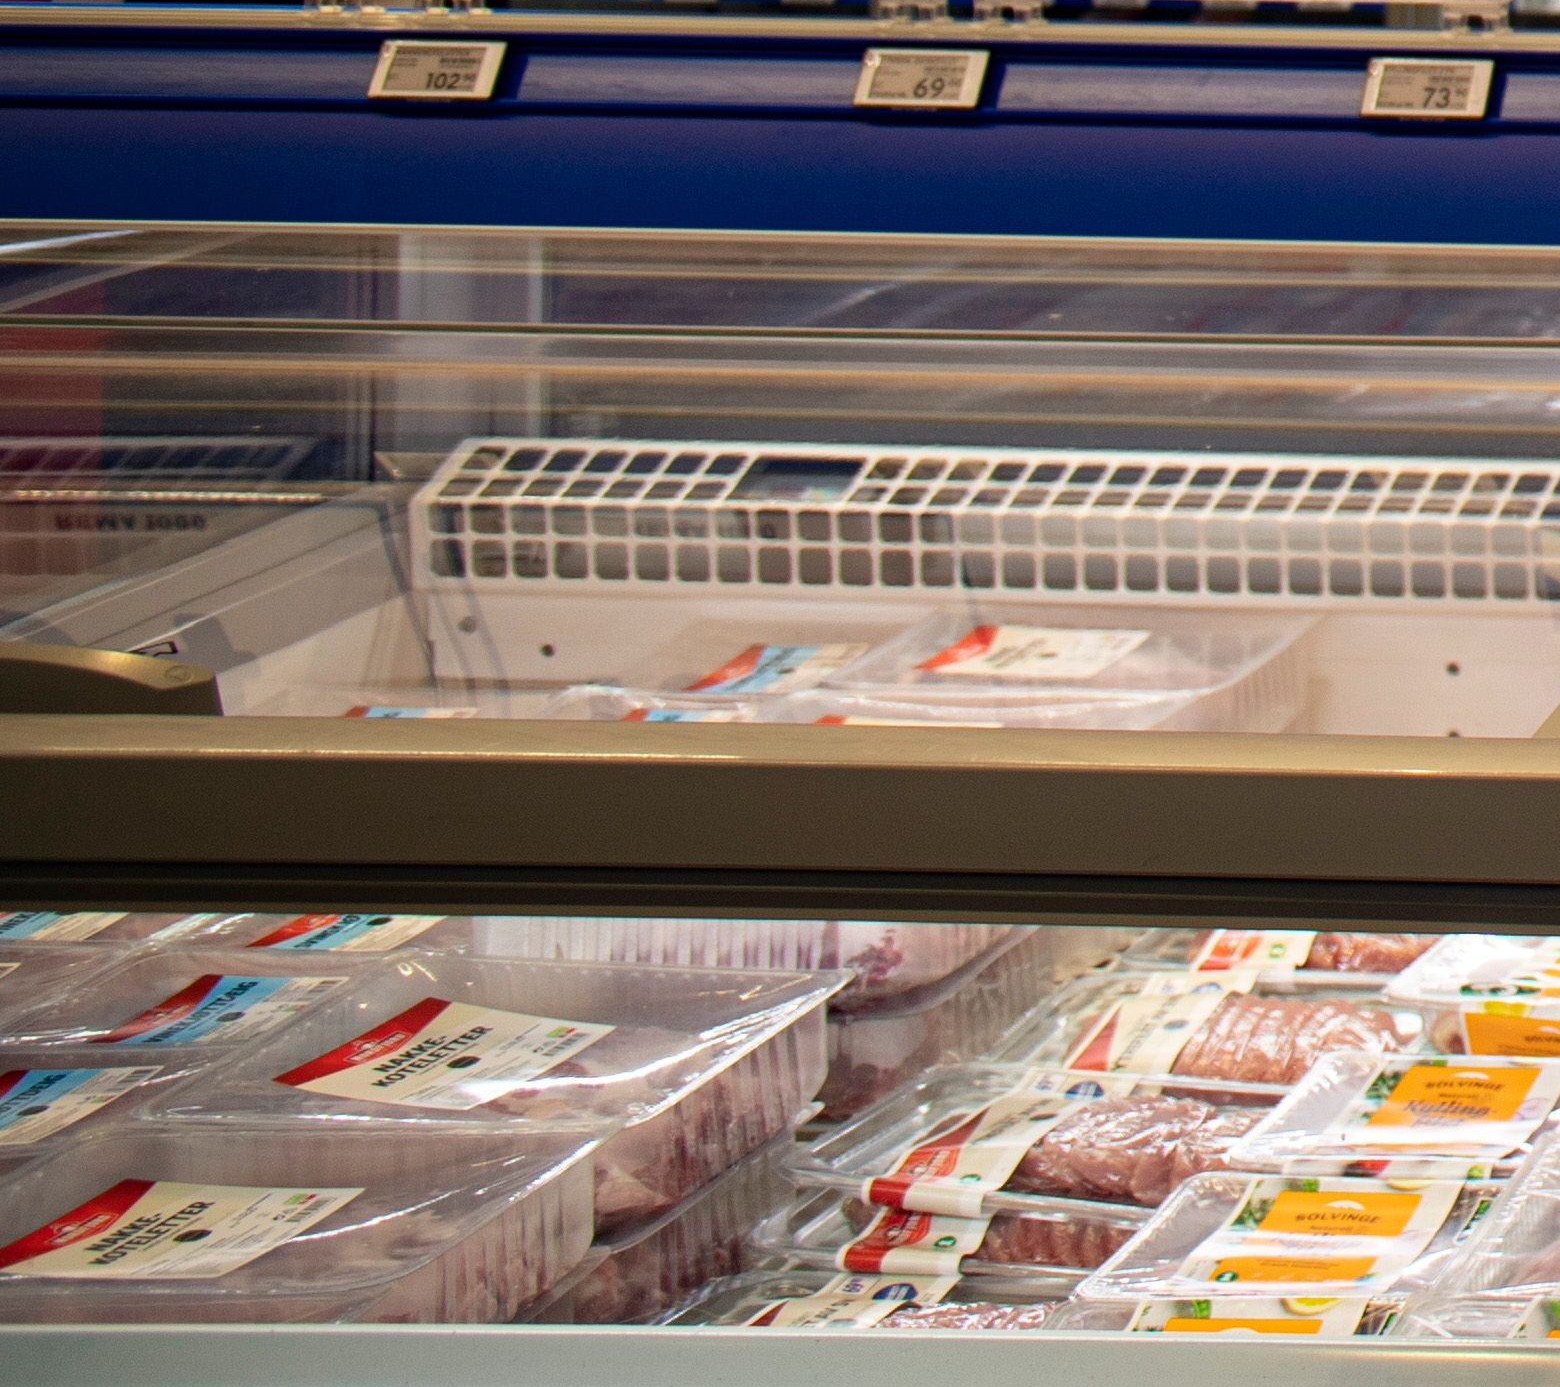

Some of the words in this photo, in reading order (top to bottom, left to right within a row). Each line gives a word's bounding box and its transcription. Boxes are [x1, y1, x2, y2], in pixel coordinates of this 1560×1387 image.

[425, 73, 457, 91] 102
[1421, 88, 1451, 108] 73
[370, 1025, 494, 1089] KOTELETTER
[376, 1034, 447, 1075] NAKKE-
[85, 1211, 165, 1252] NAKKE-
[88, 1200, 214, 1266] KOTELETTER
[1295, 1212, 1380, 1225] SOLVINGE
